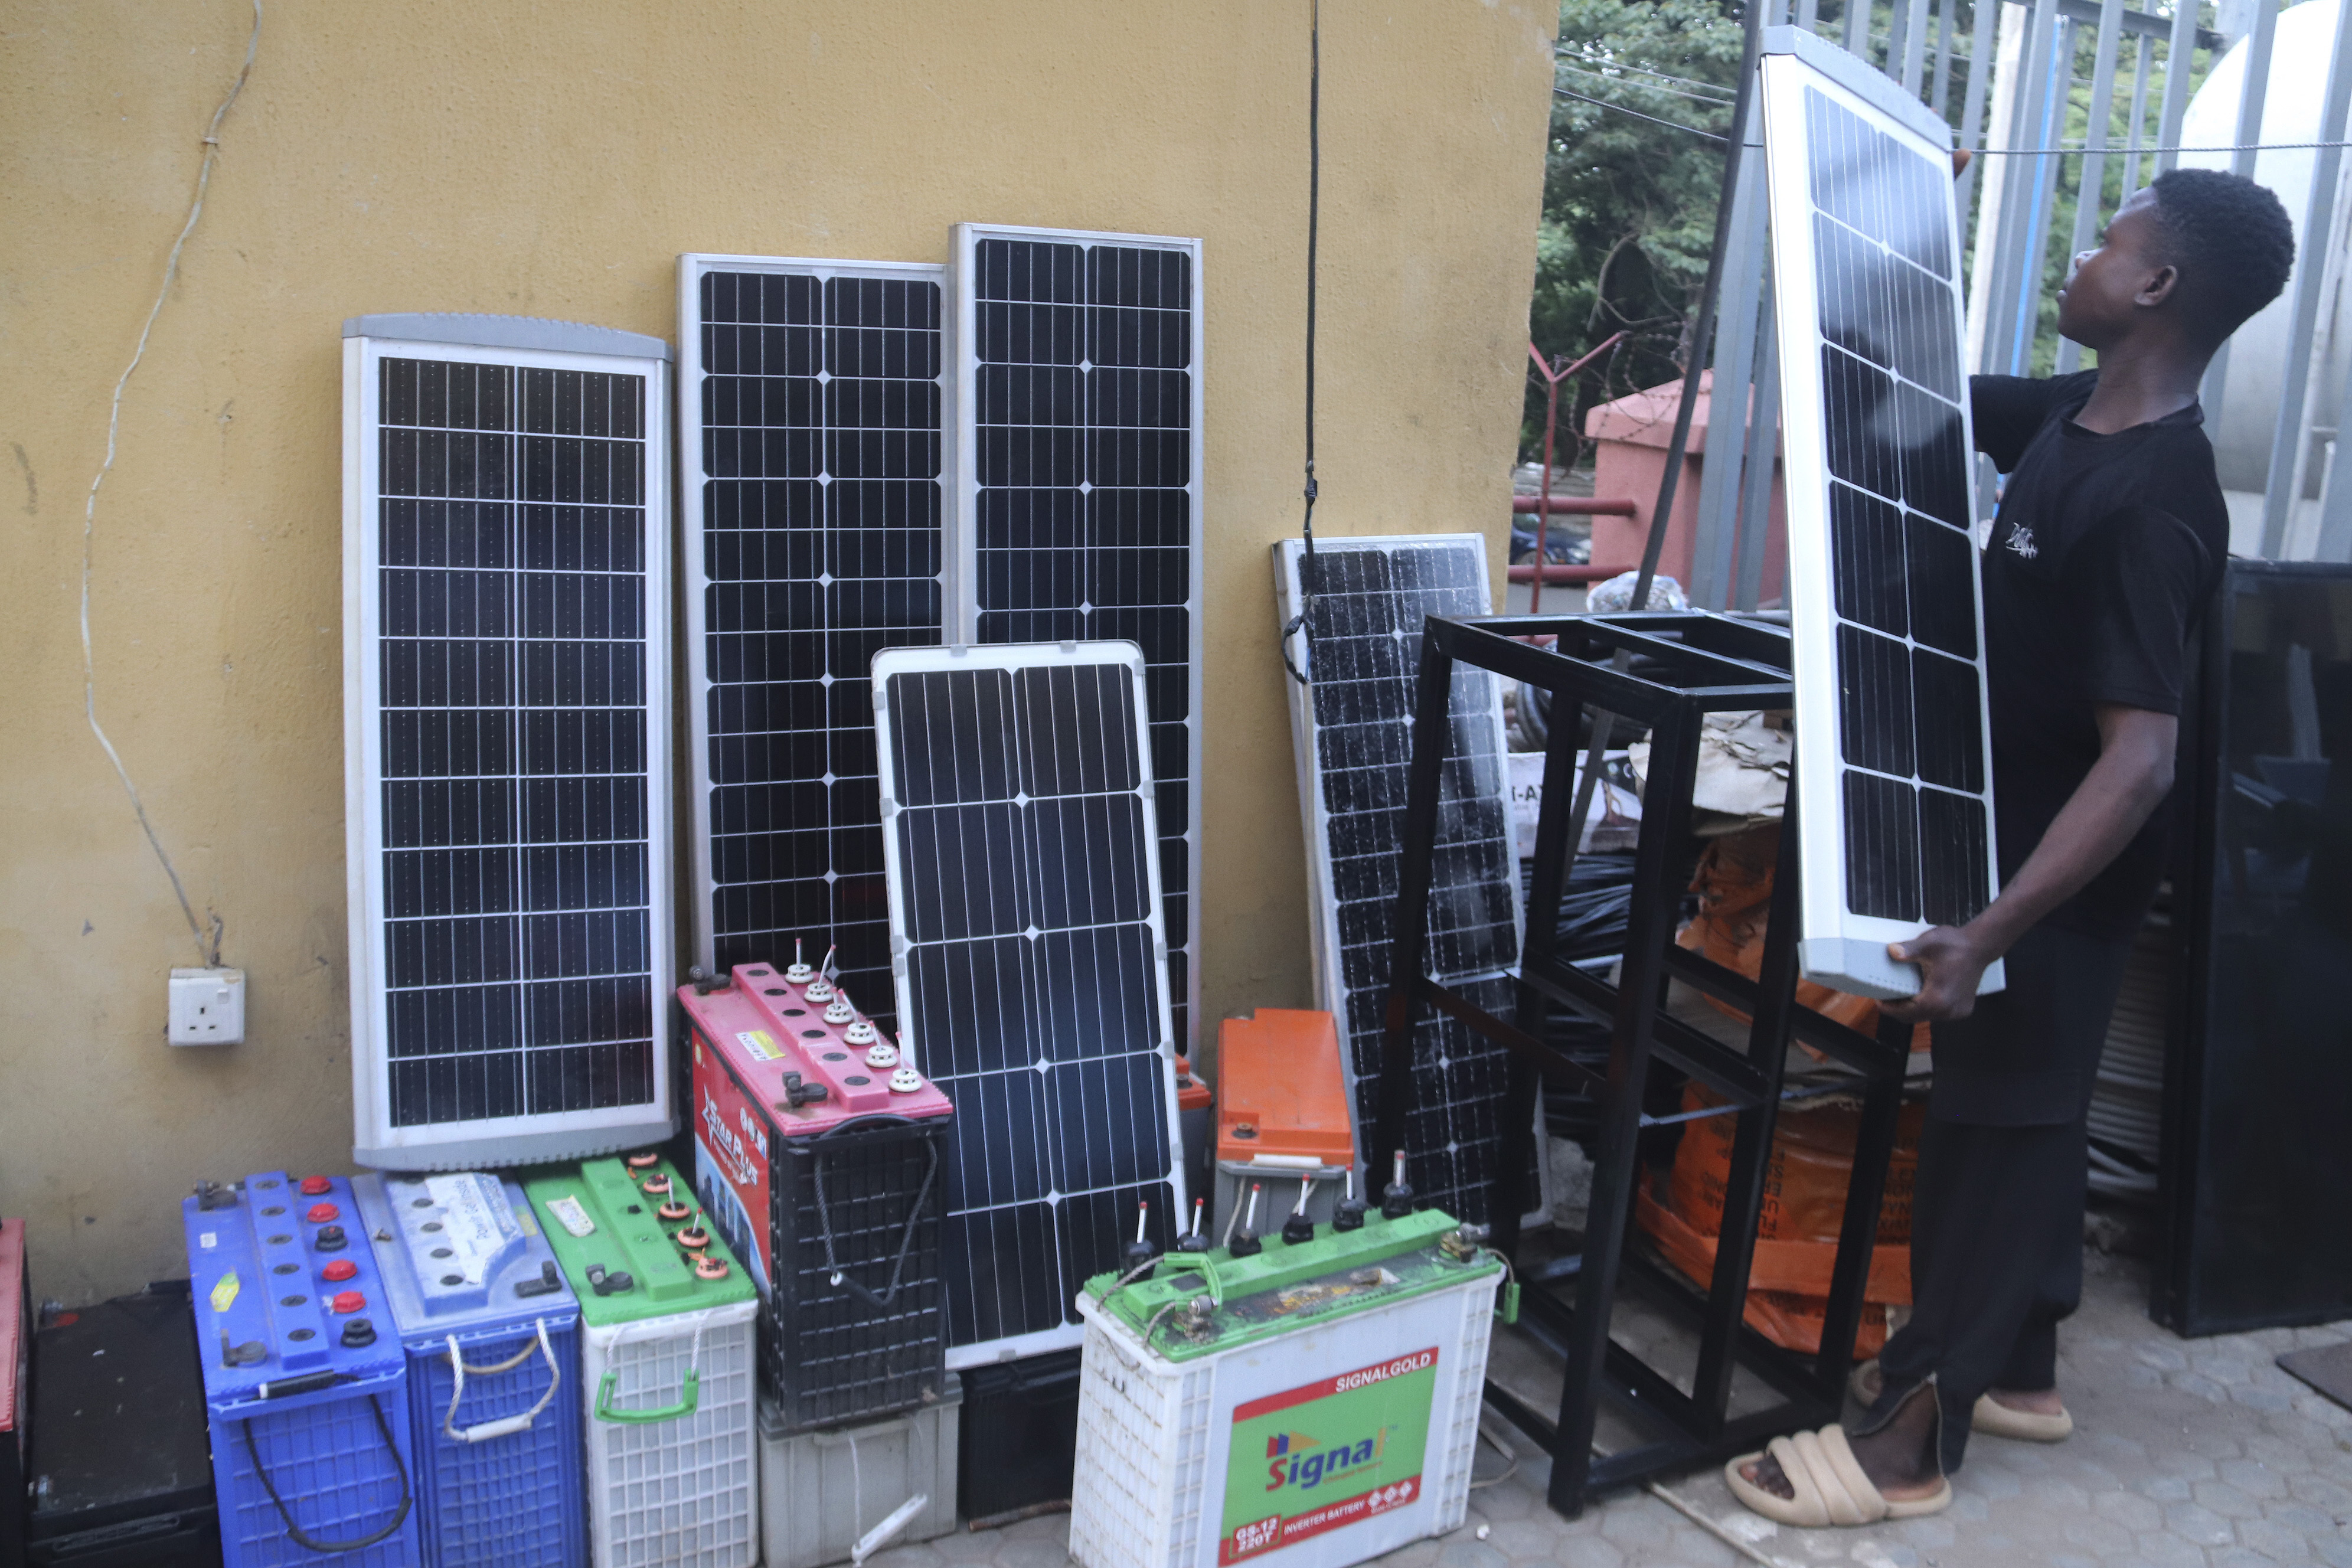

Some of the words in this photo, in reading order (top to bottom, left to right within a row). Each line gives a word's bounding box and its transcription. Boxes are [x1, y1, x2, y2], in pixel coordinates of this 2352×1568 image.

[1265, 1427, 1387, 1492] Signal
[1283, 1512, 1326, 1535] INVERTER
[1327, 1500, 1366, 1520] BATTERY
